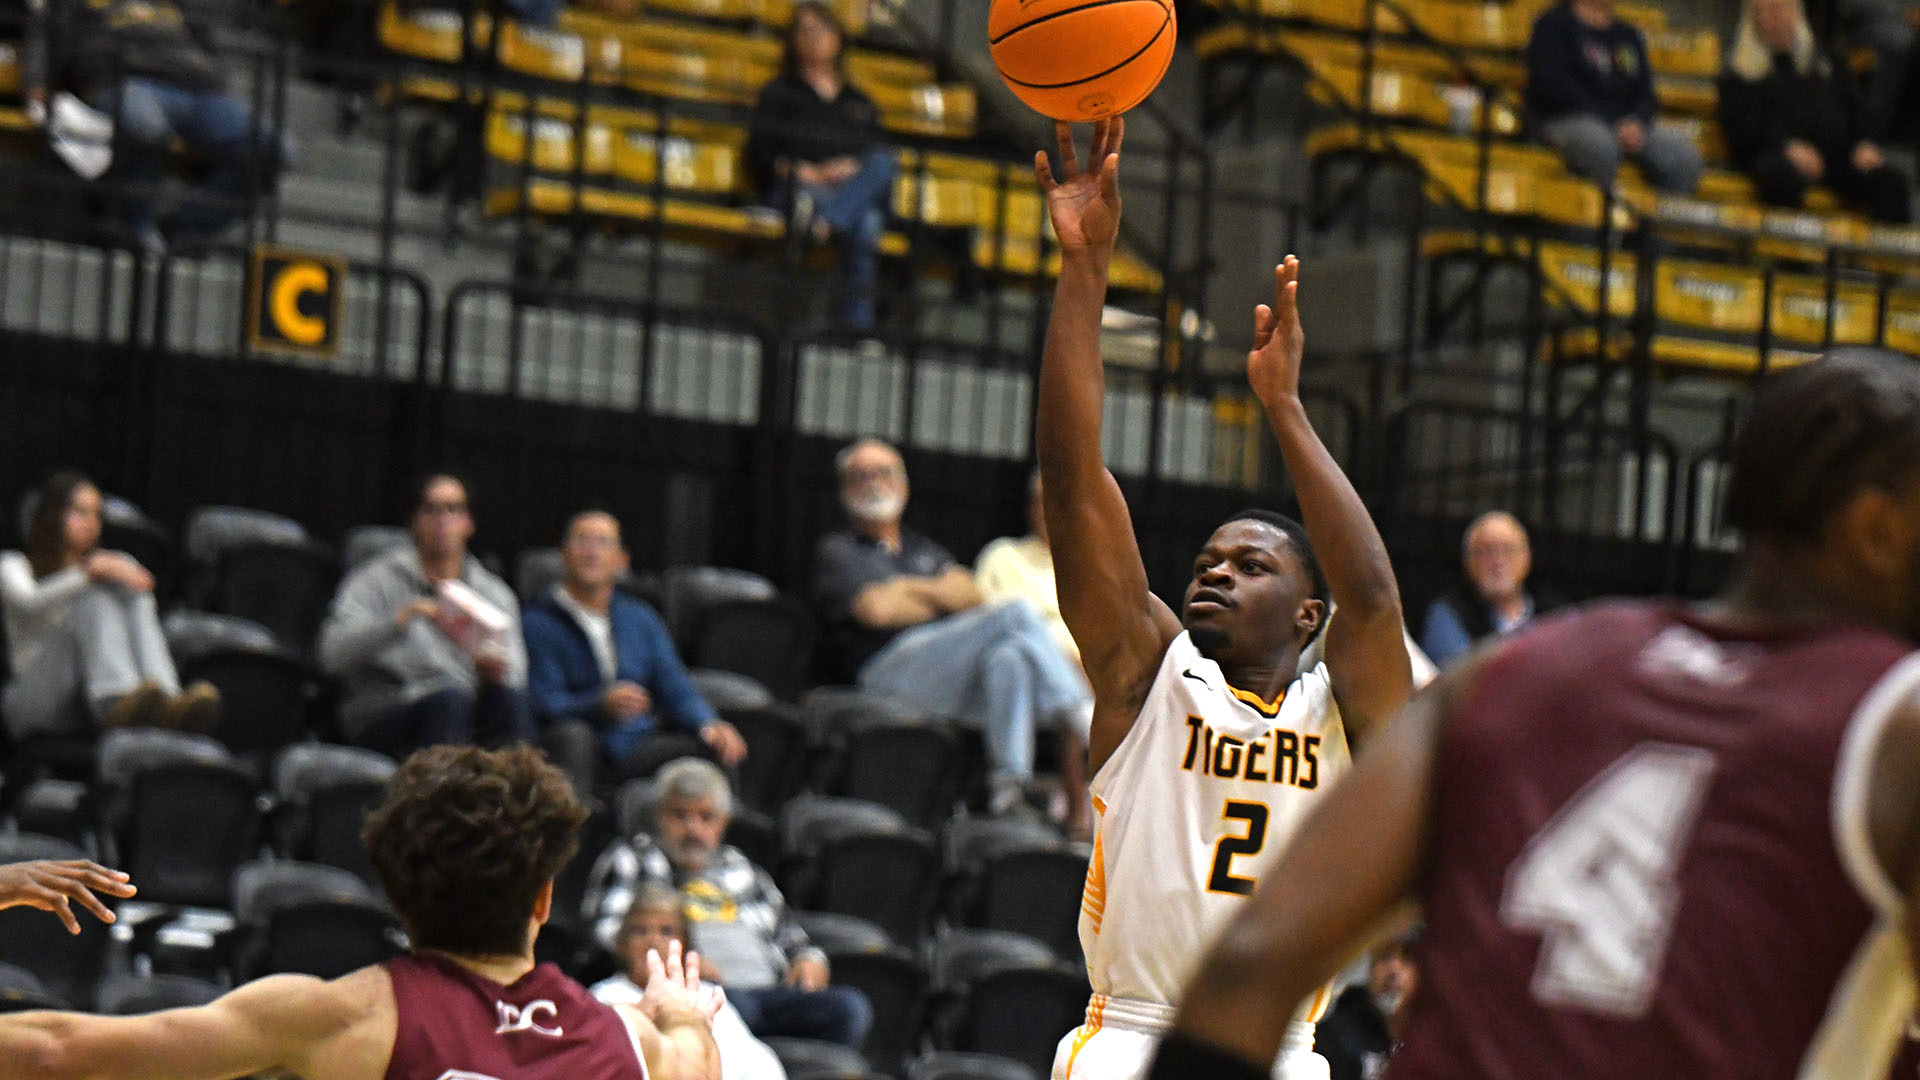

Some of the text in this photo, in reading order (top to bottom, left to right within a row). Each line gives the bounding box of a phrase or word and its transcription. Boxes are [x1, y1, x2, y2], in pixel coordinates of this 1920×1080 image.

[268, 261, 329, 345] C
[1182, 714, 1321, 790] TIGERS
[1205, 798, 1271, 898] 2
[1498, 741, 1719, 1018] 4
